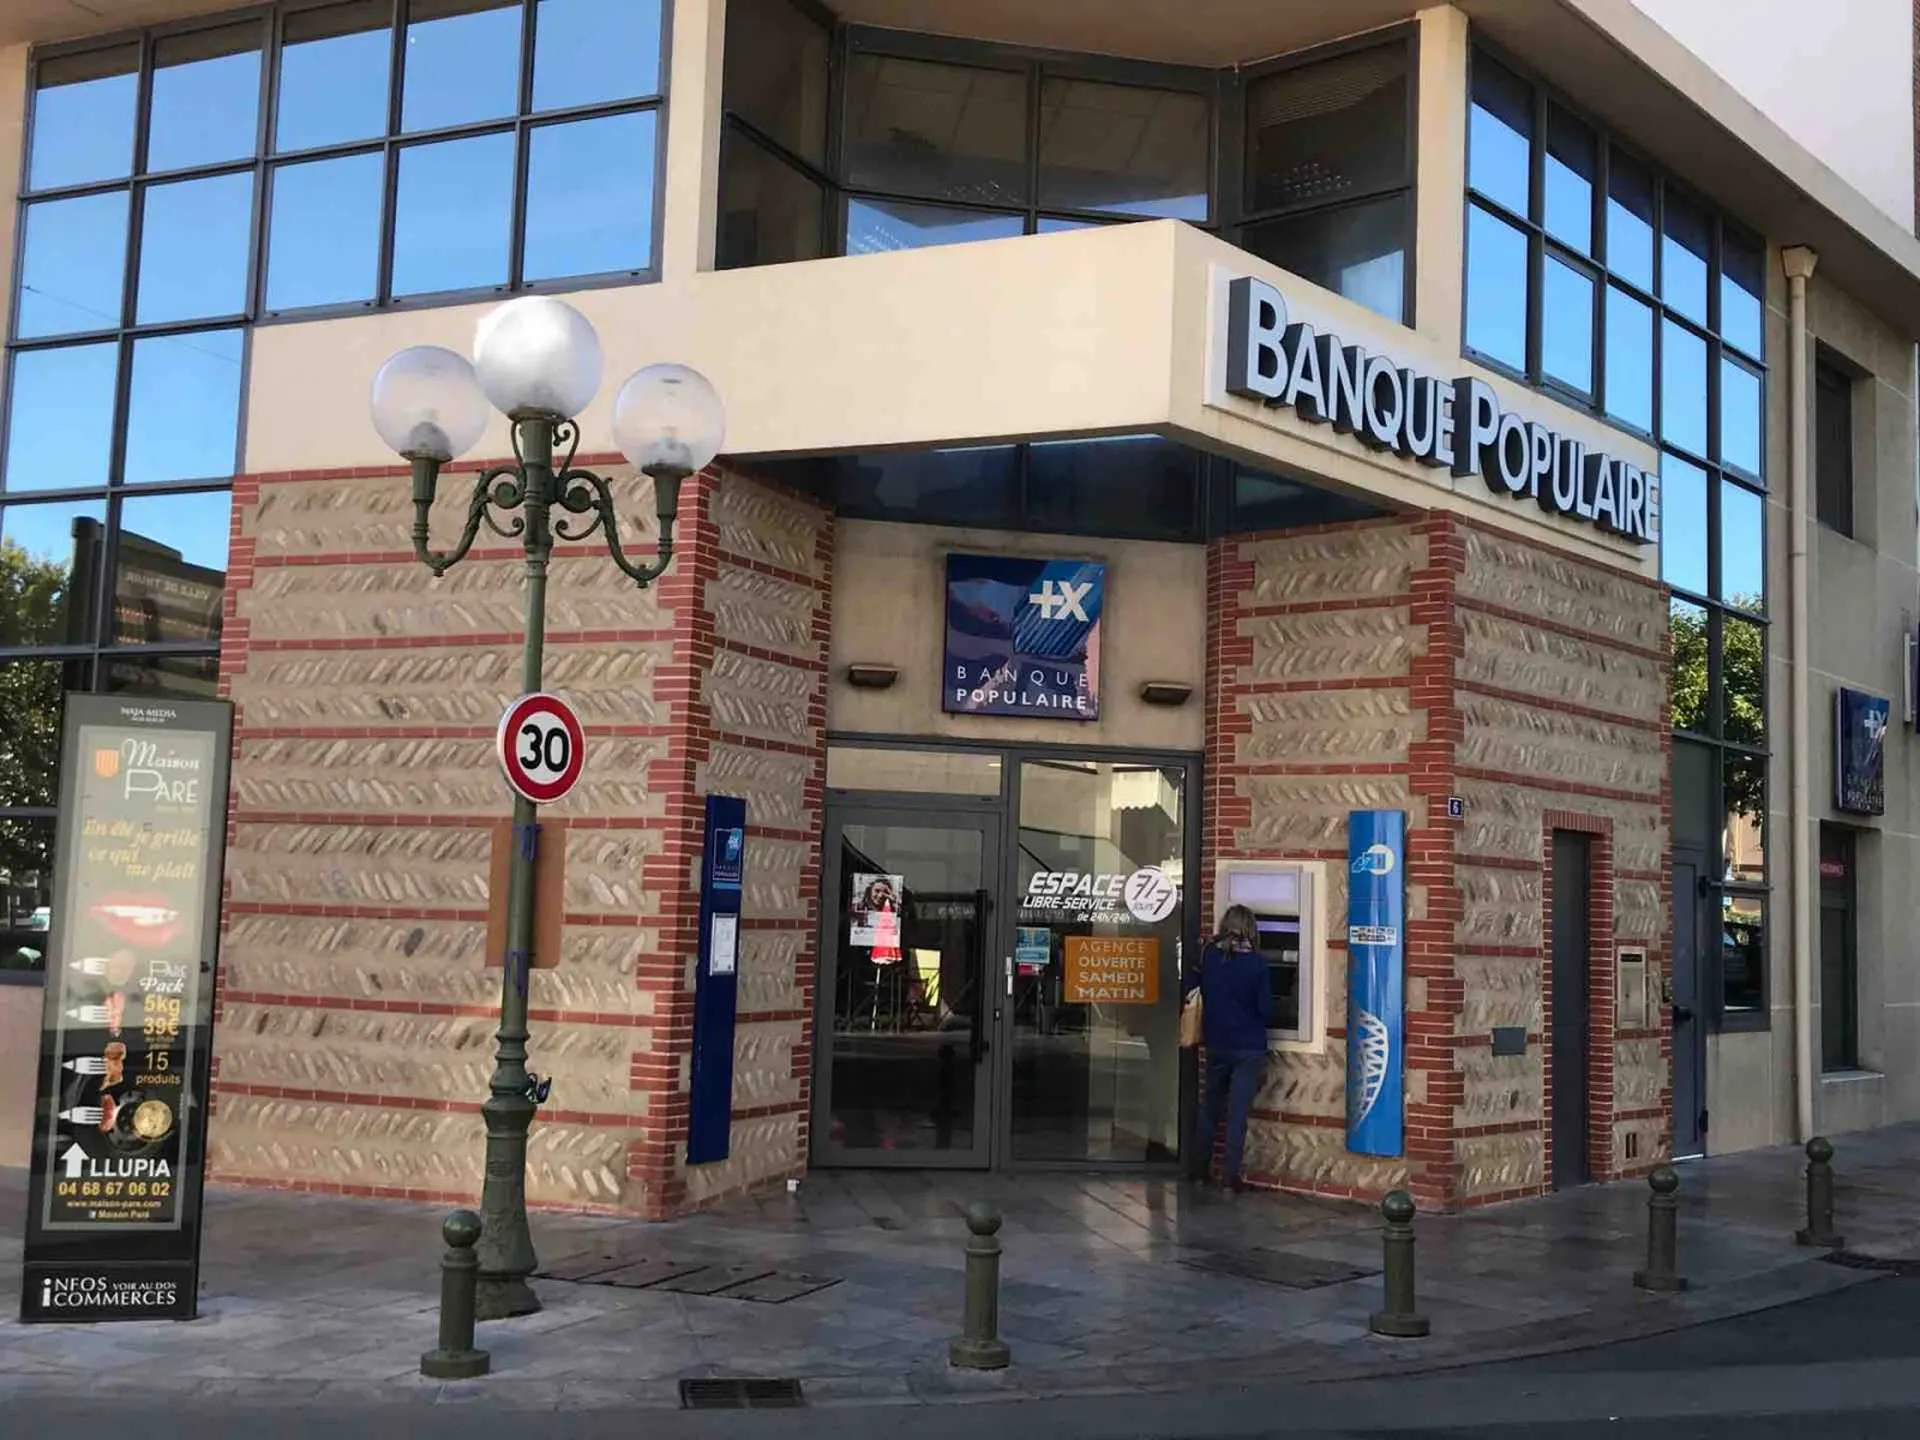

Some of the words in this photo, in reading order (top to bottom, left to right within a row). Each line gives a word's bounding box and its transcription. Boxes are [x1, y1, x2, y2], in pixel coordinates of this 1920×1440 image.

[1228, 276, 1456, 467] BANQUE
[1453, 377, 1659, 544] POPULAIRE
[956, 666, 1088, 687] BANQUE
[956, 688, 1088, 710] POPULAIRE
[121, 738, 200, 771] Maison
[519, 723, 570, 773] 30
[1028, 871, 1127, 897] ESPACE
[1023, 895, 1117, 911] LIBRE-SERVICE
[1079, 941, 1146, 953] AGENCE
[1078, 956, 1146, 968] OUVERTE
[139, 976, 186, 994] Pack
[1079, 972, 1145, 984] SAMEDI
[1079, 987, 1144, 999] MATIN
[143, 1017, 180, 1036] 39€
[145, 1051, 169, 1071] 15
[135, 1073, 182, 1086] produits
[90, 1158, 171, 1178] LLUPIA
[58, 1181, 77, 1196] 04
[82, 1181, 101, 1196] 68
[105, 1182, 124, 1196] 67
[128, 1182, 147, 1196] 06
[151, 1182, 171, 1197] 02
[112, 1282, 137, 1291] VOIR
[138, 1282, 154, 1291] AU
[155, 1281, 178, 1290] DOS
[54, 1290, 177, 1307] COMMERCES
